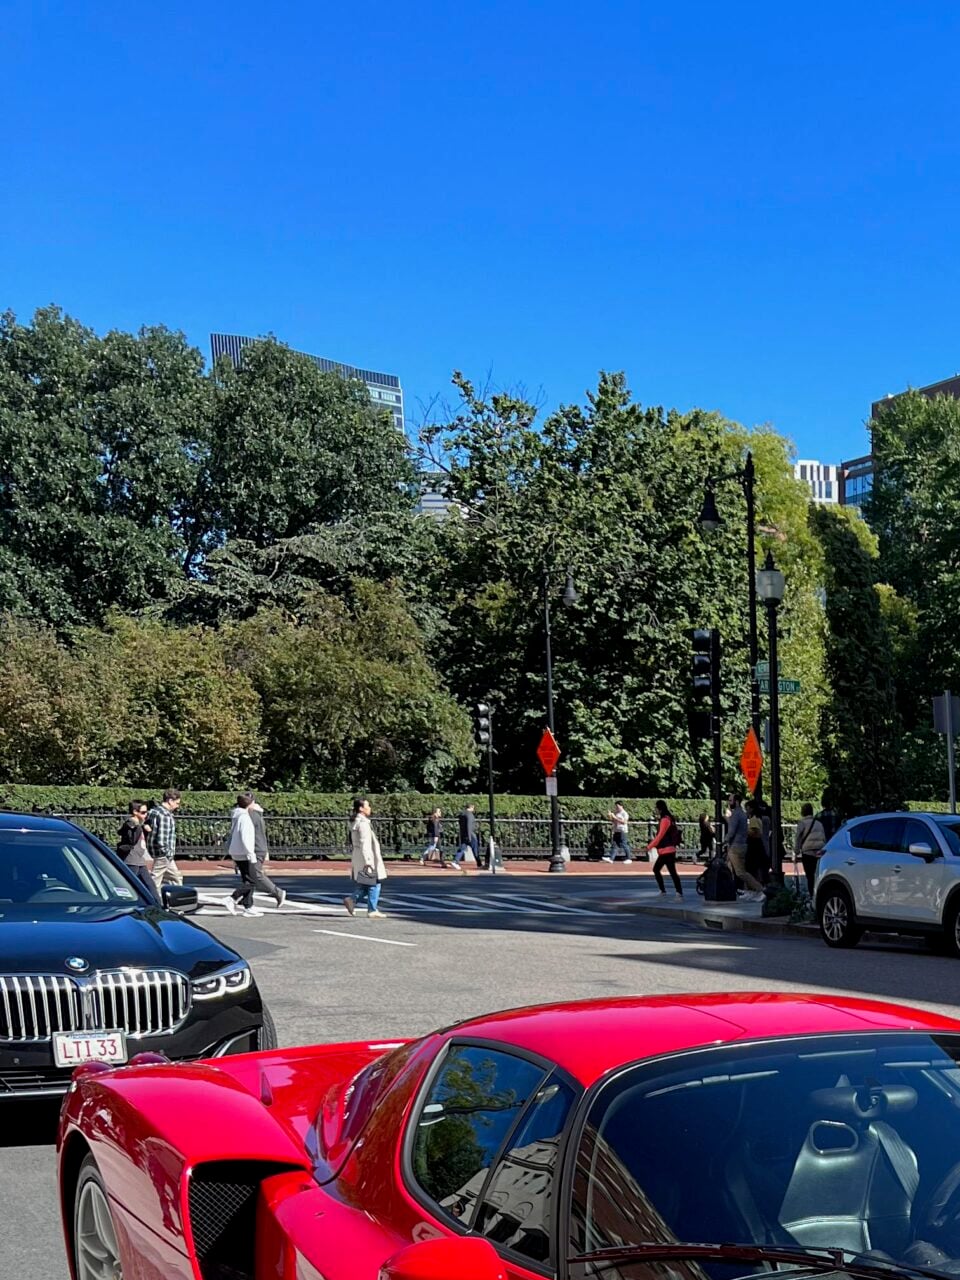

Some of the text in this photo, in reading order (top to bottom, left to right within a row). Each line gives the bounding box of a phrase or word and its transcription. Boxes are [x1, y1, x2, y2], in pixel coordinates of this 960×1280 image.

[760, 681, 795, 691] ARGTON
[63, 1040, 116, 1058] LTI 33
